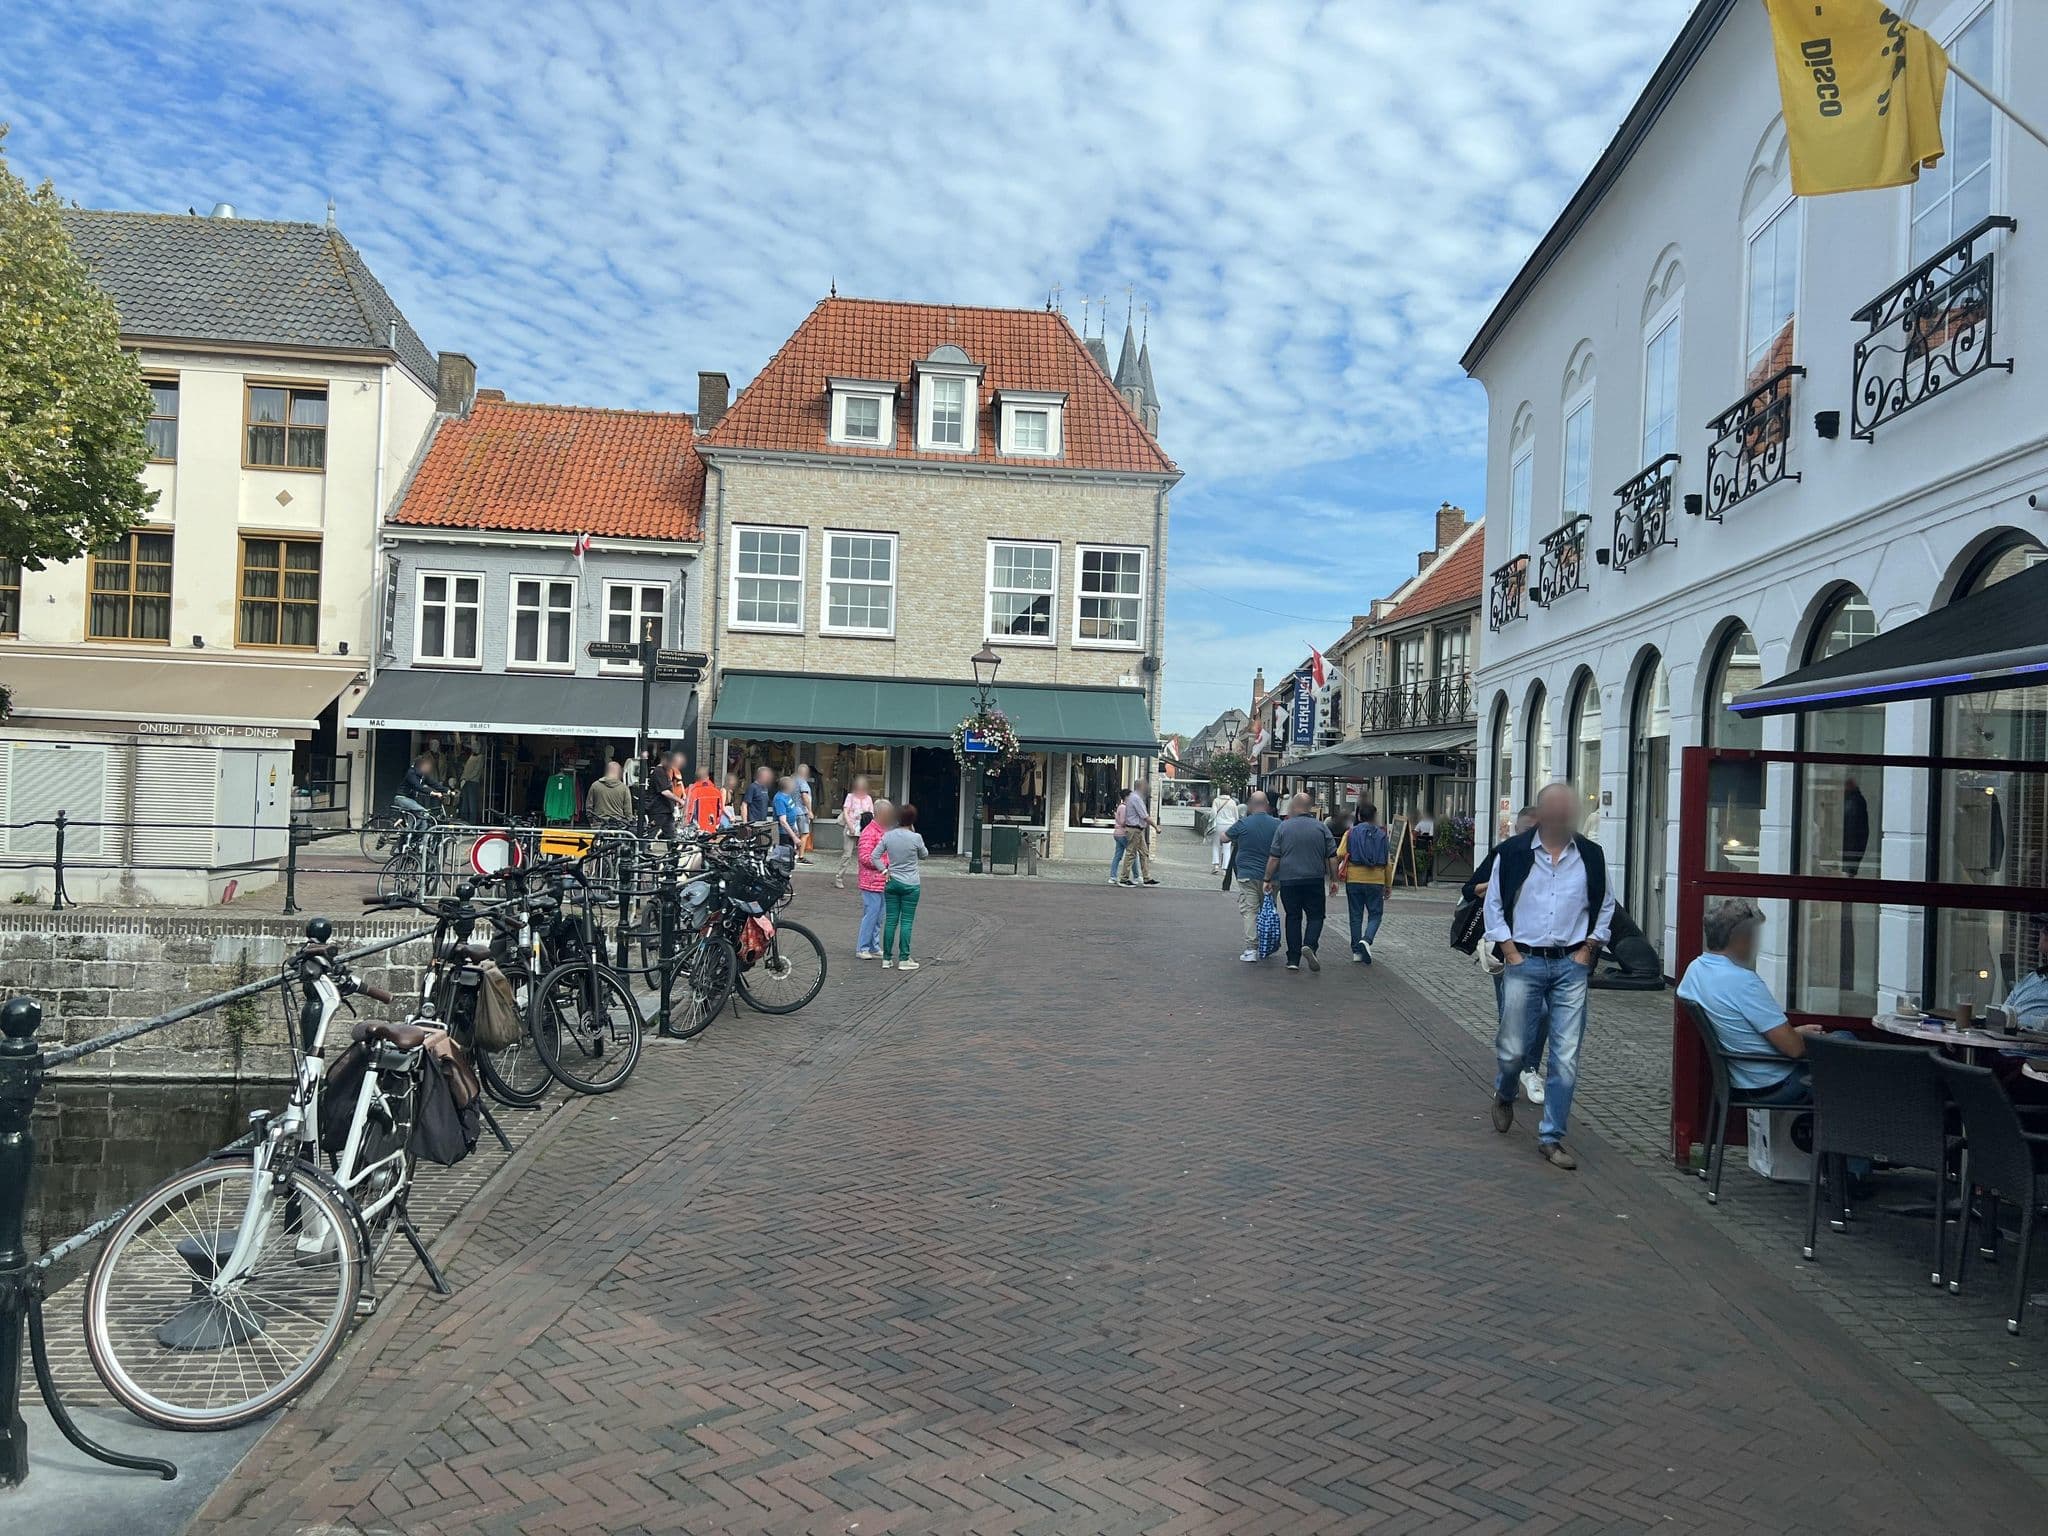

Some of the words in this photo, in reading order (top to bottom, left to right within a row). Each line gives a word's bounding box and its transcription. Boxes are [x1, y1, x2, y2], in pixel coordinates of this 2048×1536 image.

[138, 722, 185, 734] ONTBIJT
[193, 724, 235, 736] LUNCH
[244, 727, 279, 738] DINER
[1085, 755, 1116, 765] Barbour
